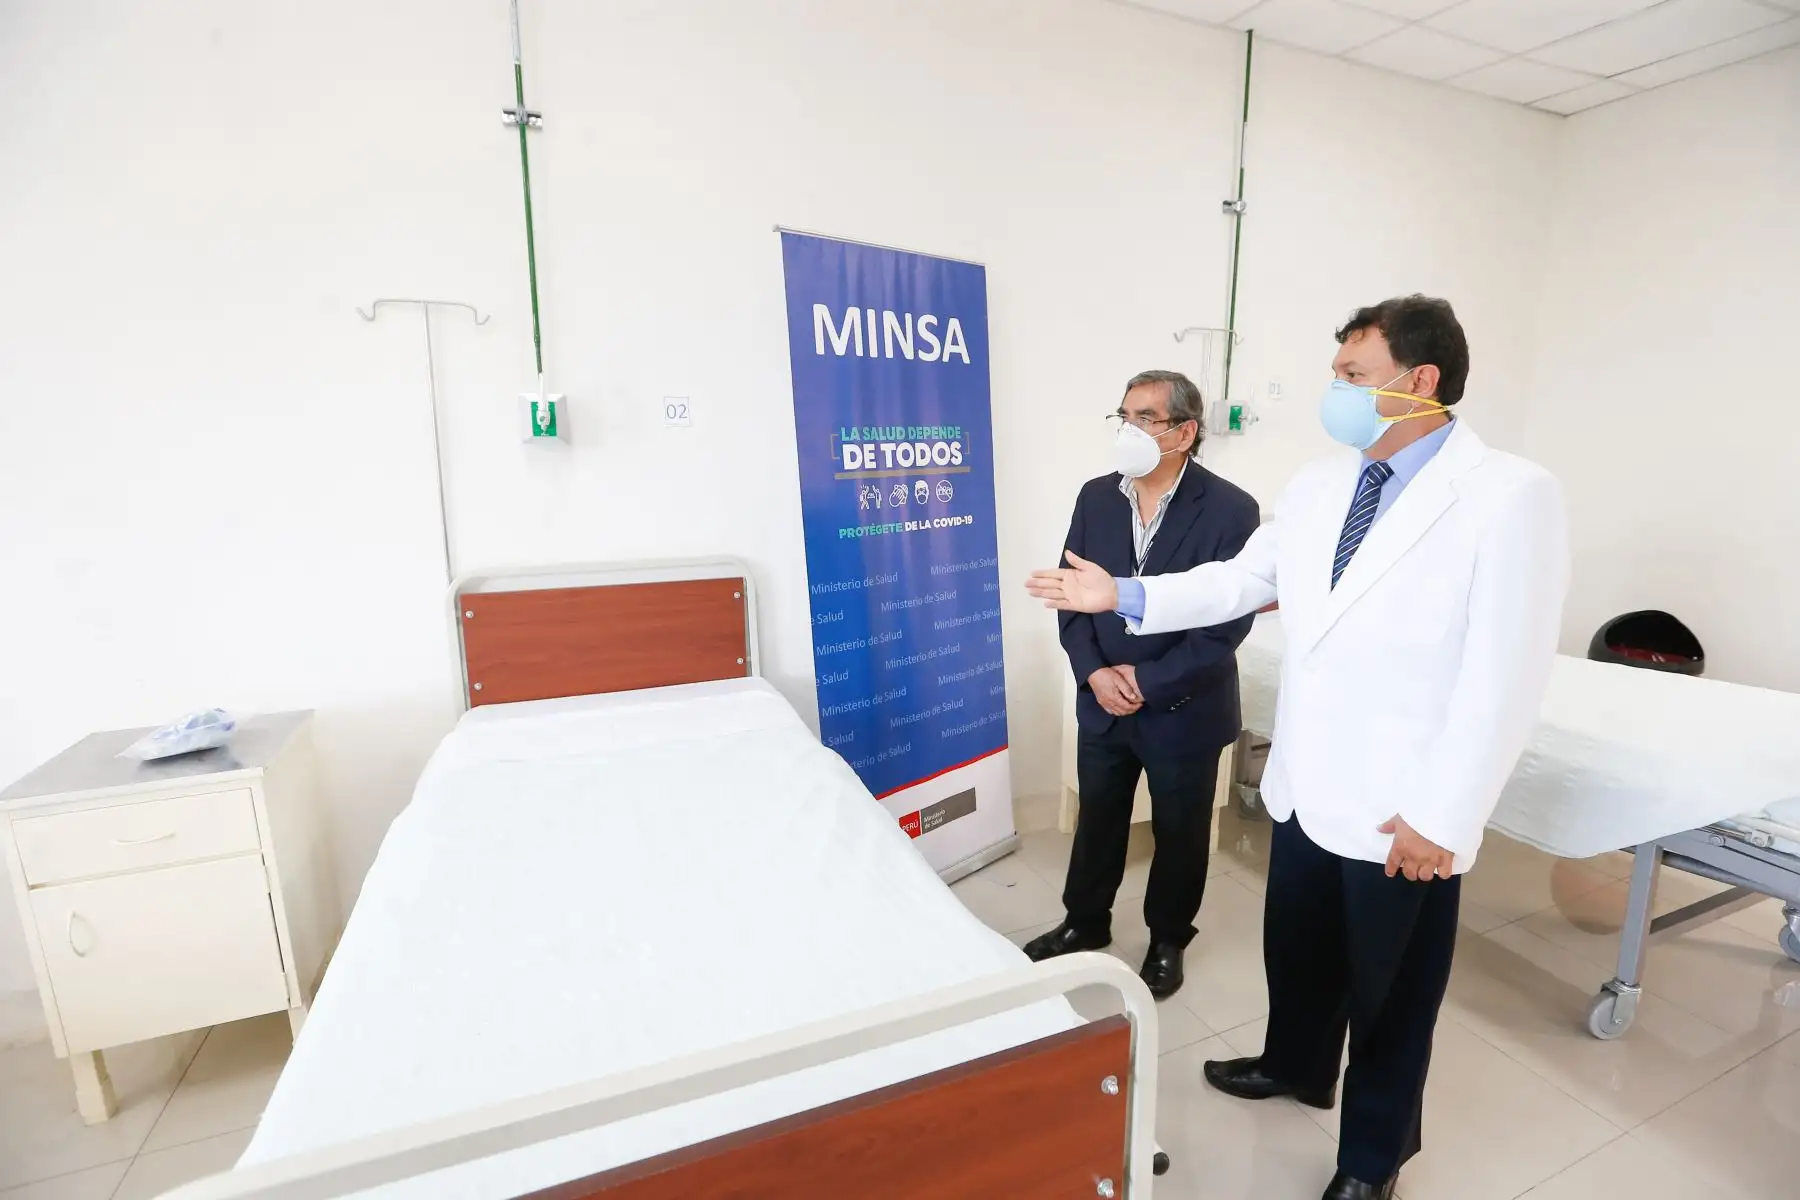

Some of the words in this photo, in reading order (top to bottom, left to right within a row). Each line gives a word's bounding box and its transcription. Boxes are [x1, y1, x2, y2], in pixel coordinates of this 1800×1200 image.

[812, 303, 971, 365] MINSA
[666, 403, 688, 419] 02
[841, 427, 860, 441] LA
[863, 427, 905, 441] SALUD
[908, 426, 961, 440] DEPENDE
[842, 443, 877, 470] DE
[880, 441, 963, 468] TODOS
[838, 522, 902, 539] PROTÉGETE
[904, 520, 918, 532] DE
[919, 519, 931, 530] LA
[933, 515, 973, 528] COVID-19
[930, 561, 968, 576] Ministerio
[969, 560, 978, 569] de
[811, 579, 861, 595] Ministerio
[863, 576, 873, 587] de
[875, 571, 898, 585] Salud
[881, 596, 923, 613] Ministerio
[924, 594, 933, 604] de
[934, 590, 957, 603] Salud
[816, 609, 844, 624] Salud
[934, 616, 972, 630] Ministerio
[972, 612, 981, 621] de
[816, 638, 866, 656] Ministerio
[868, 634, 878, 646] de
[880, 629, 903, 643] Salud
[885, 651, 928, 670] Ministerio
[928, 648, 937, 659] de
[938, 643, 960, 656] Salud
[822, 669, 849, 685] Salud
[937, 668, 975, 686] Ministerio
[976, 664, 985, 674] de
[822, 697, 871, 718] Ministerio
[872, 693, 883, 705] de
[884, 686, 907, 700] Salud
[890, 710, 931, 729] Ministerio
[932, 706, 941, 716] de
[942, 697, 964, 712] Salud
[828, 730, 854, 747] Salud
[941, 719, 978, 739] Ministerio
[877, 750, 887, 762] de
[888, 741, 912, 757] Salud
[902, 818, 919, 832] PERÚ
